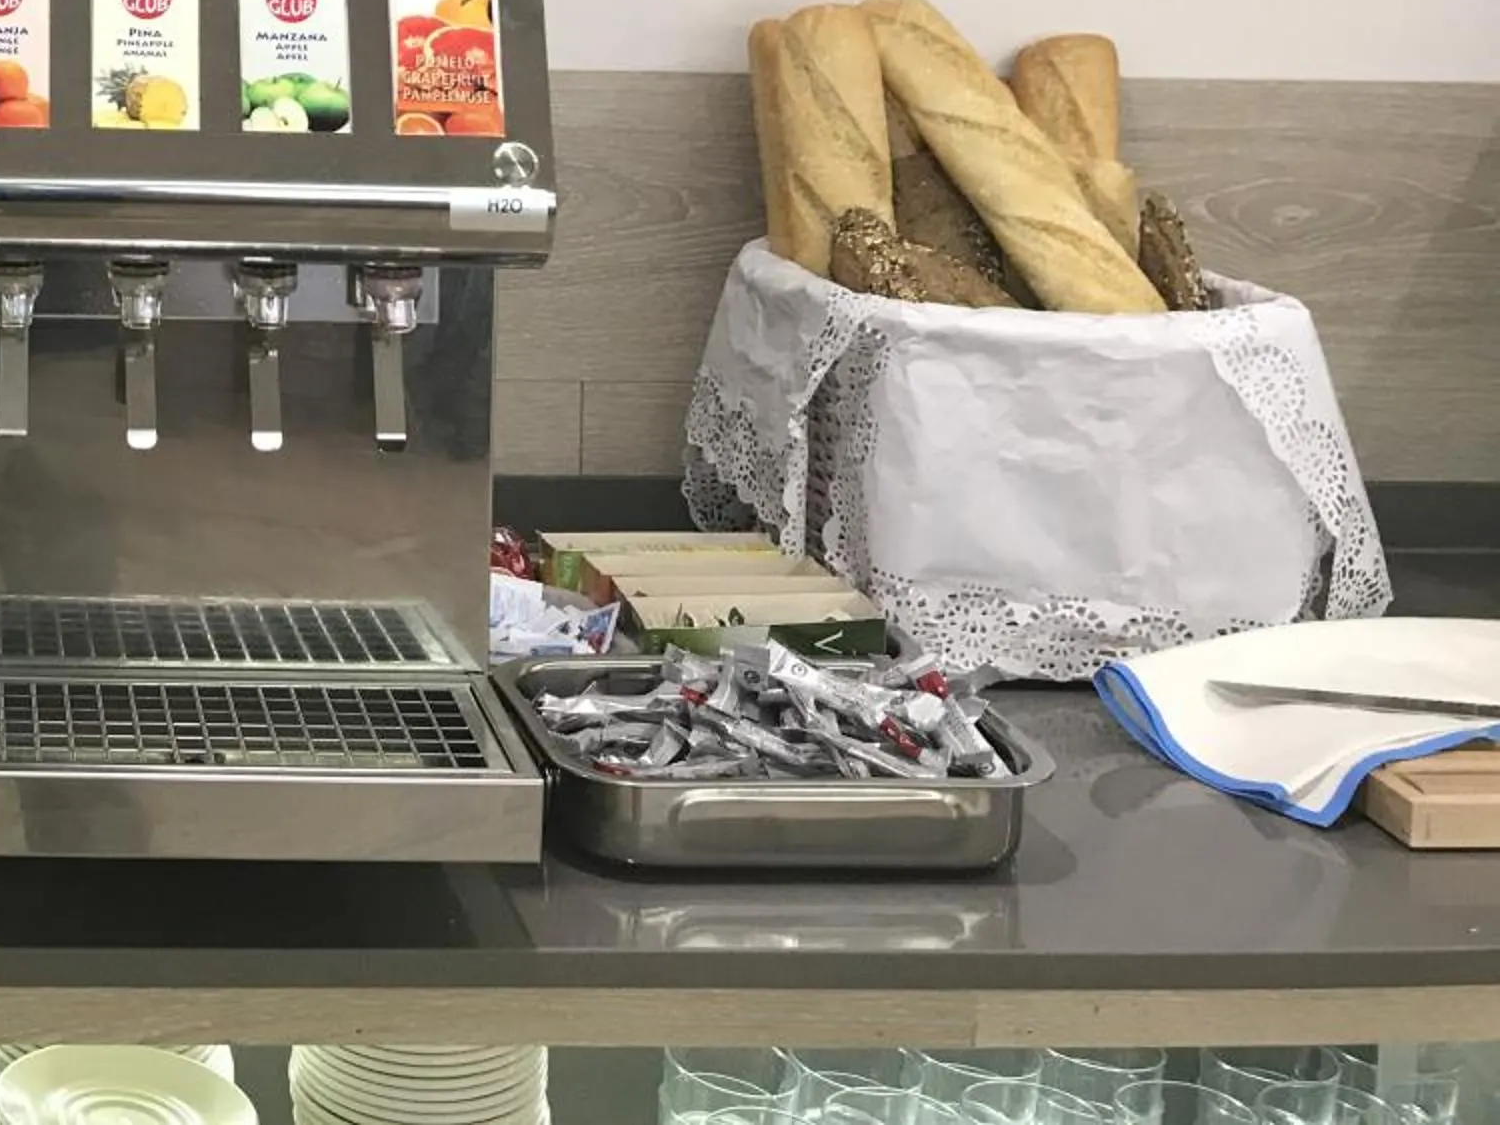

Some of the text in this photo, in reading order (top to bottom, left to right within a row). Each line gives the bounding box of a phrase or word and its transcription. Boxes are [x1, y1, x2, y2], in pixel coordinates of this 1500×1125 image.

[256, 32, 328, 42] MANZANA
[414, 54, 476, 70] POMELO
[486, 198, 523, 215] H2O
